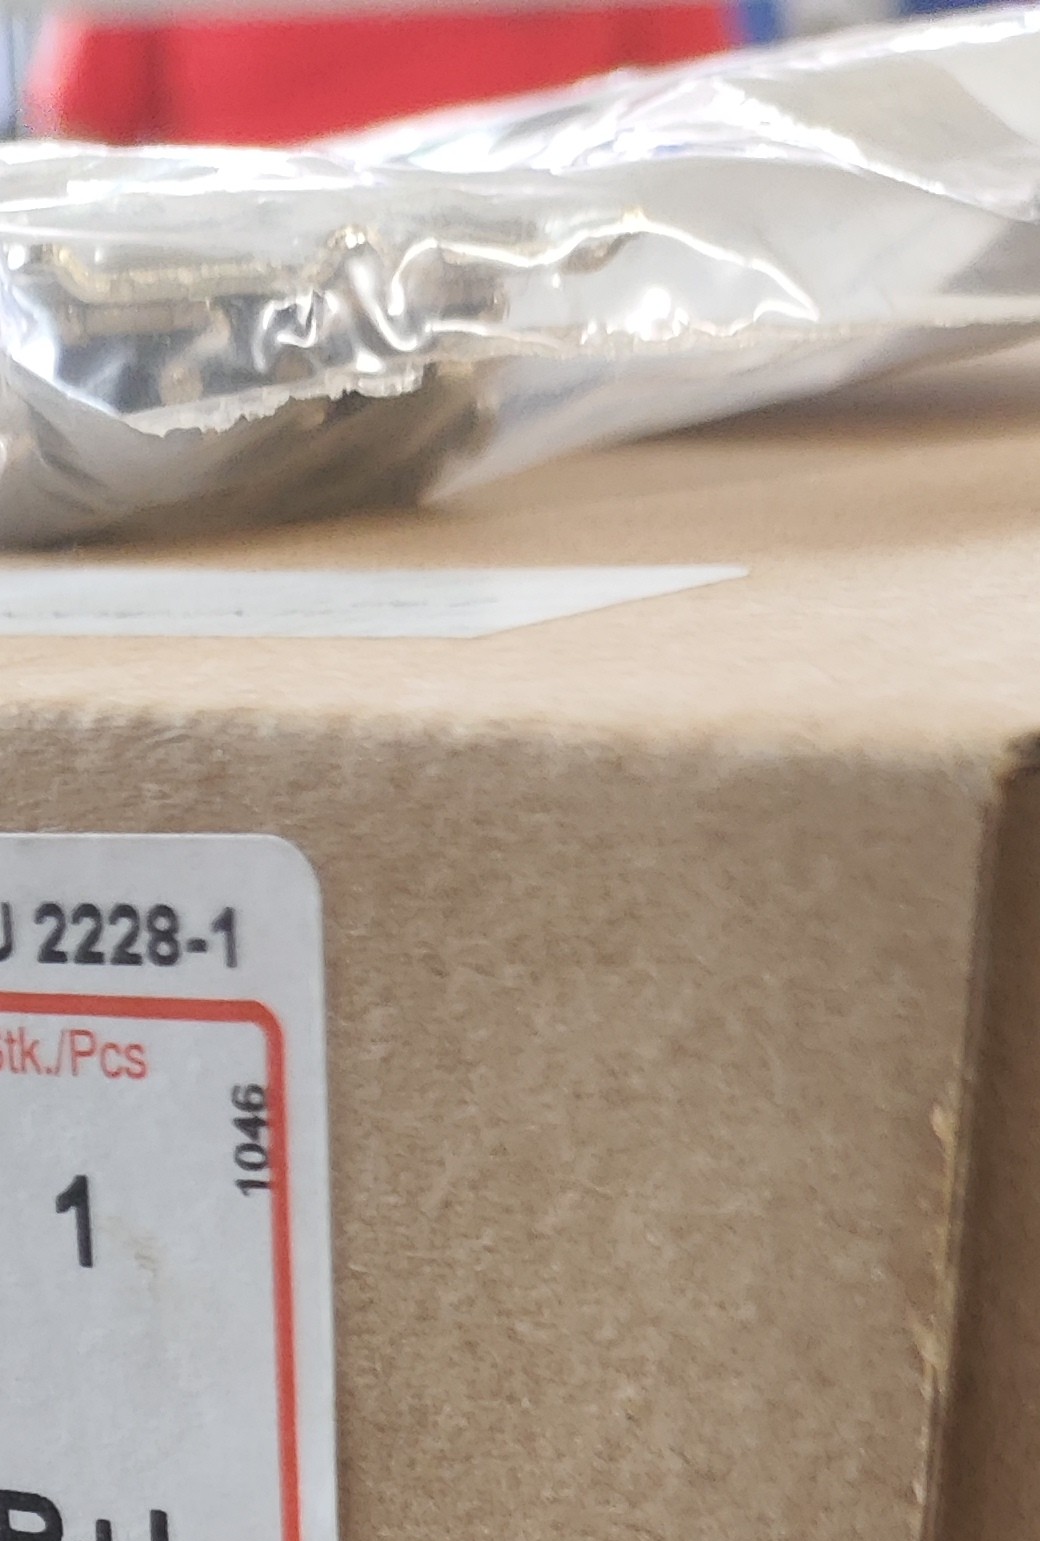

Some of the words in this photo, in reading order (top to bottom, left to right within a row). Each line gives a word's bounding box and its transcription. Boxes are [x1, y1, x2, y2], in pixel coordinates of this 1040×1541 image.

[33, 902, 241, 969] 2228-1
[230, 1082, 271, 1197] 1046
[54, 1174, 95, 1269] 1
